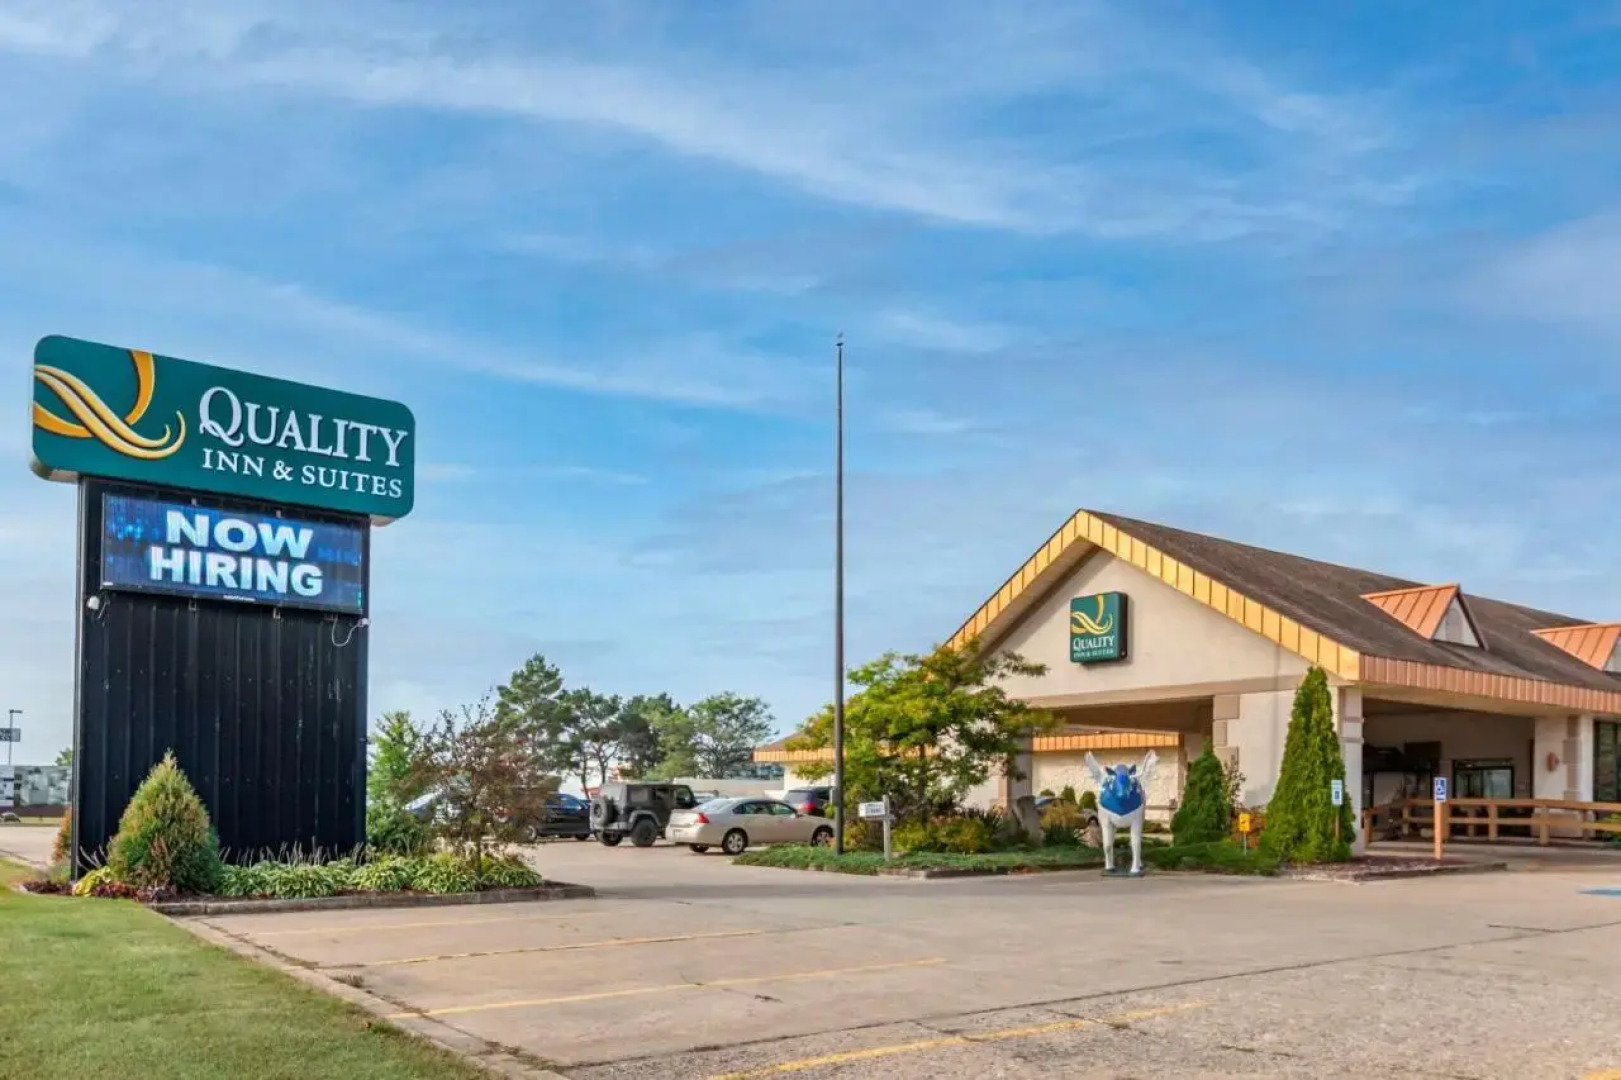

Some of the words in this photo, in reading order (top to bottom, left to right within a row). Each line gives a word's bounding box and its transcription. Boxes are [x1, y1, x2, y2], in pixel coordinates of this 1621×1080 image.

[199, 386, 408, 467] QUALITY
[202, 448, 265, 477] INN
[273, 460, 294, 481] &
[301, 465, 402, 498] SUITES
[166, 510, 313, 559] NOW
[151, 546, 323, 597] HIRING
[1073, 635, 1115, 652] QUALITY
